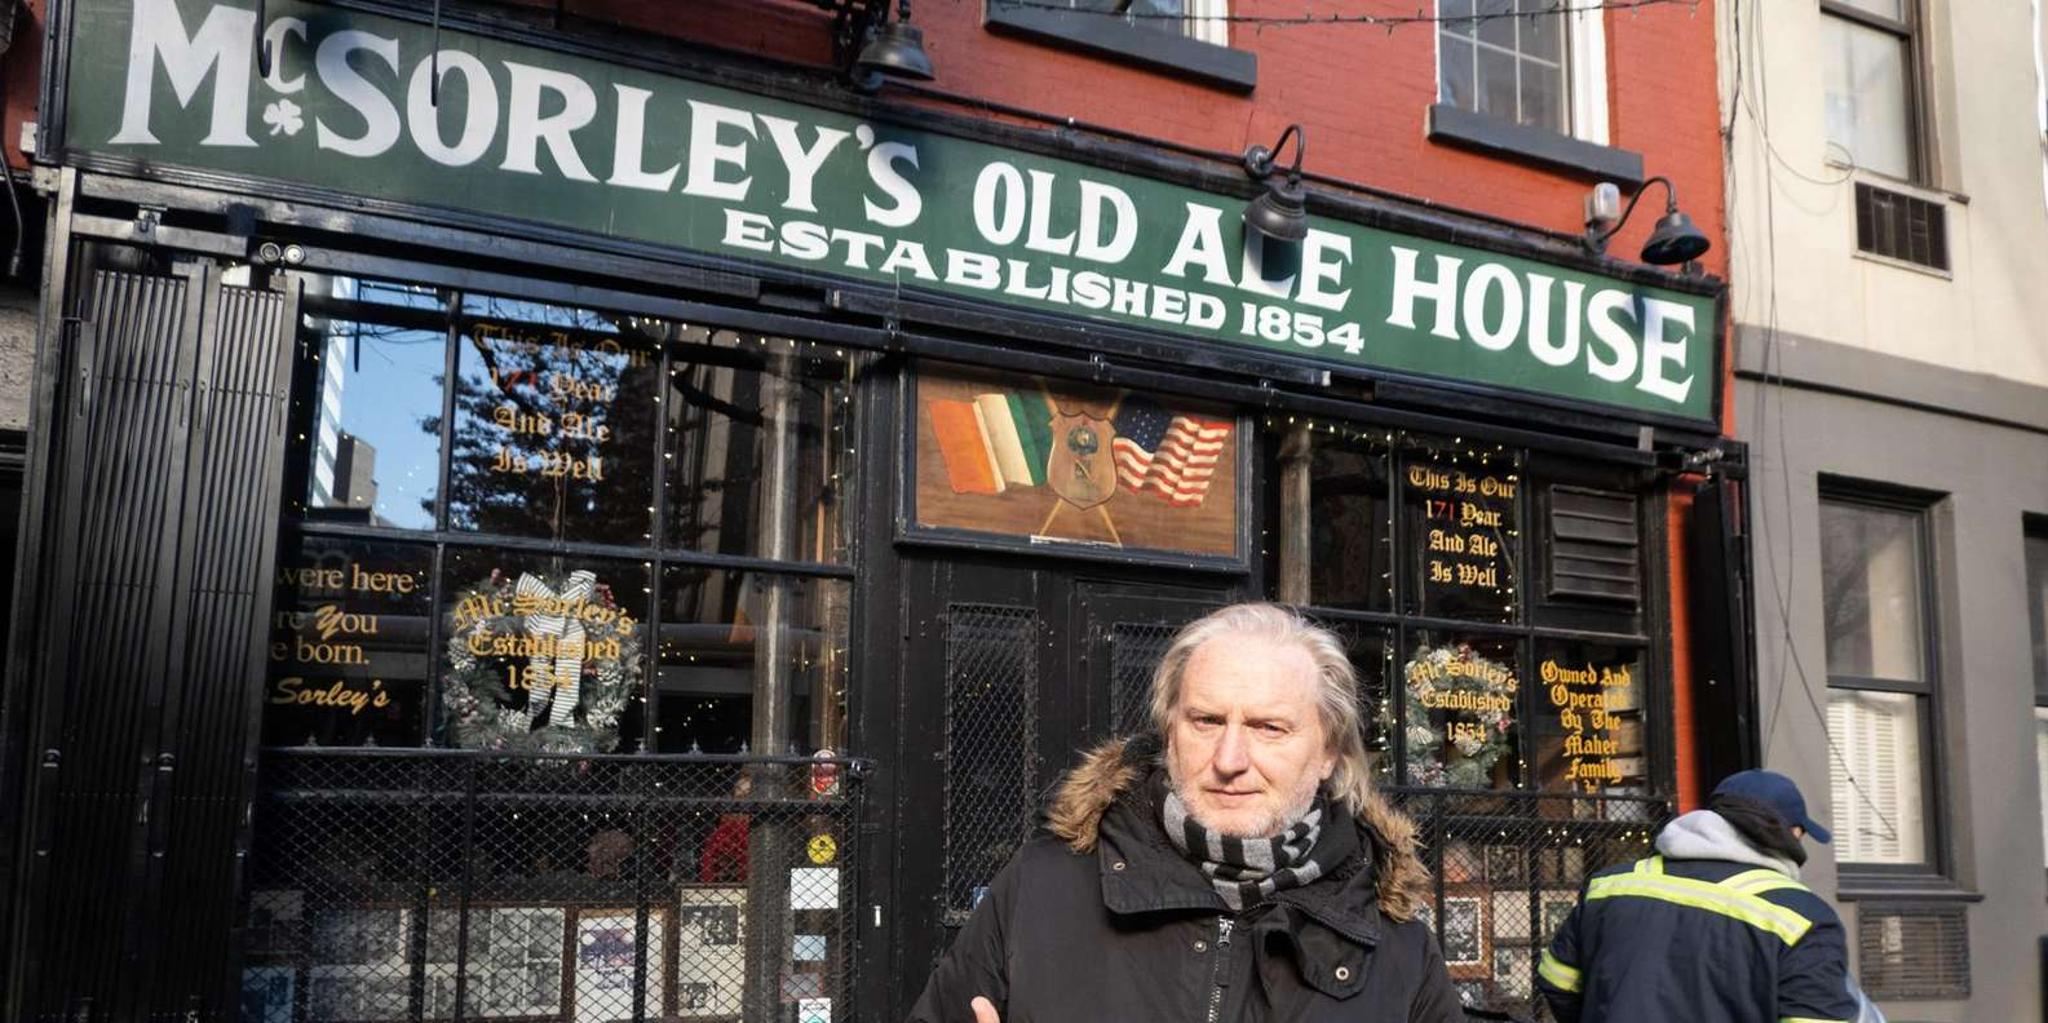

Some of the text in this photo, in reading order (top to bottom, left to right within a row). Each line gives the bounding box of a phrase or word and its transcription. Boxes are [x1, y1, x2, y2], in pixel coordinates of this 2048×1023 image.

[722, 208, 1365, 356] ESTABLISHED 1854
[972, 161, 1138, 264] OLD
[1161, 202, 1353, 313] ALE
[1385, 245, 1696, 404] HOUSE
[493, 406, 611, 442] And Ale
[490, 444, 605, 481] Is Well
[1408, 465, 1517, 499] This Is Our
[1426, 499, 1455, 521] 171
[1429, 529, 1498, 557] And Ale
[350, 562, 414, 593] here
[1430, 560, 1498, 588] Is Well
[315, 603, 379, 641] You
[296, 635, 371, 665] born.
[1541, 660, 1631, 688] Owned And
[270, 676, 392, 716] Sorley's
[1420, 687, 1512, 713] Established
[1447, 722, 1487, 742] 1854
[1561, 709, 1622, 736] By The
[1562, 735, 1619, 757] Maher
[1565, 758, 1623, 784] Family
